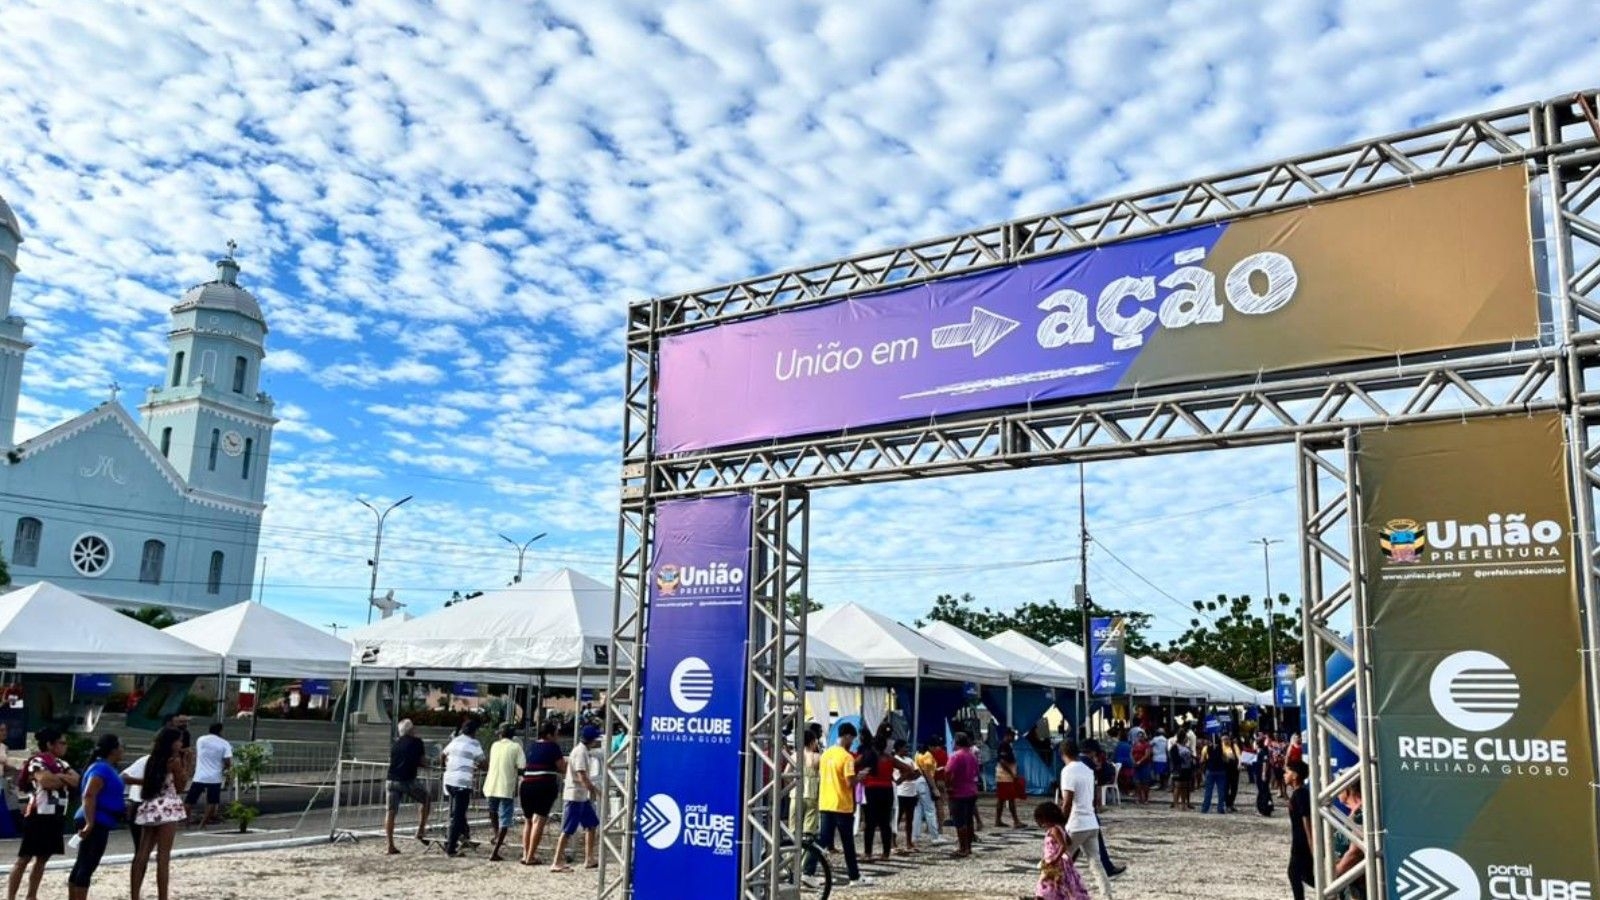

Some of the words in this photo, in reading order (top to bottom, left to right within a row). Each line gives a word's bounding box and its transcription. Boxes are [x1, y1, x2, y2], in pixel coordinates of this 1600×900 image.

[775, 341, 863, 381] União
[871, 337, 918, 365] em
[1036, 246, 1298, 350] ação
[1426, 512, 1562, 549] União
[1431, 546, 1560, 562] PREFEITURA
[680, 562, 744, 586] União
[680, 586, 742, 595] PREFEITURA
[651, 716, 685, 733] REDE
[687, 717, 732, 735] CLUBE
[650, 734, 695, 743] AFILIADA
[698, 735, 732, 745] GLOBO
[1398, 736, 1469, 760] REDE
[1474, 737, 1568, 763] CLUBE
[1400, 761, 1490, 774] AFILIADA
[1502, 764, 1570, 777] GLOBO
[684, 804, 708, 813] portal
[684, 812, 735, 833] CLUBE
[683, 828, 734, 849] NEWS
[713, 845, 733, 856] .com
[1487, 864, 1533, 877] portal
[1488, 875, 1592, 900] CLUBE
